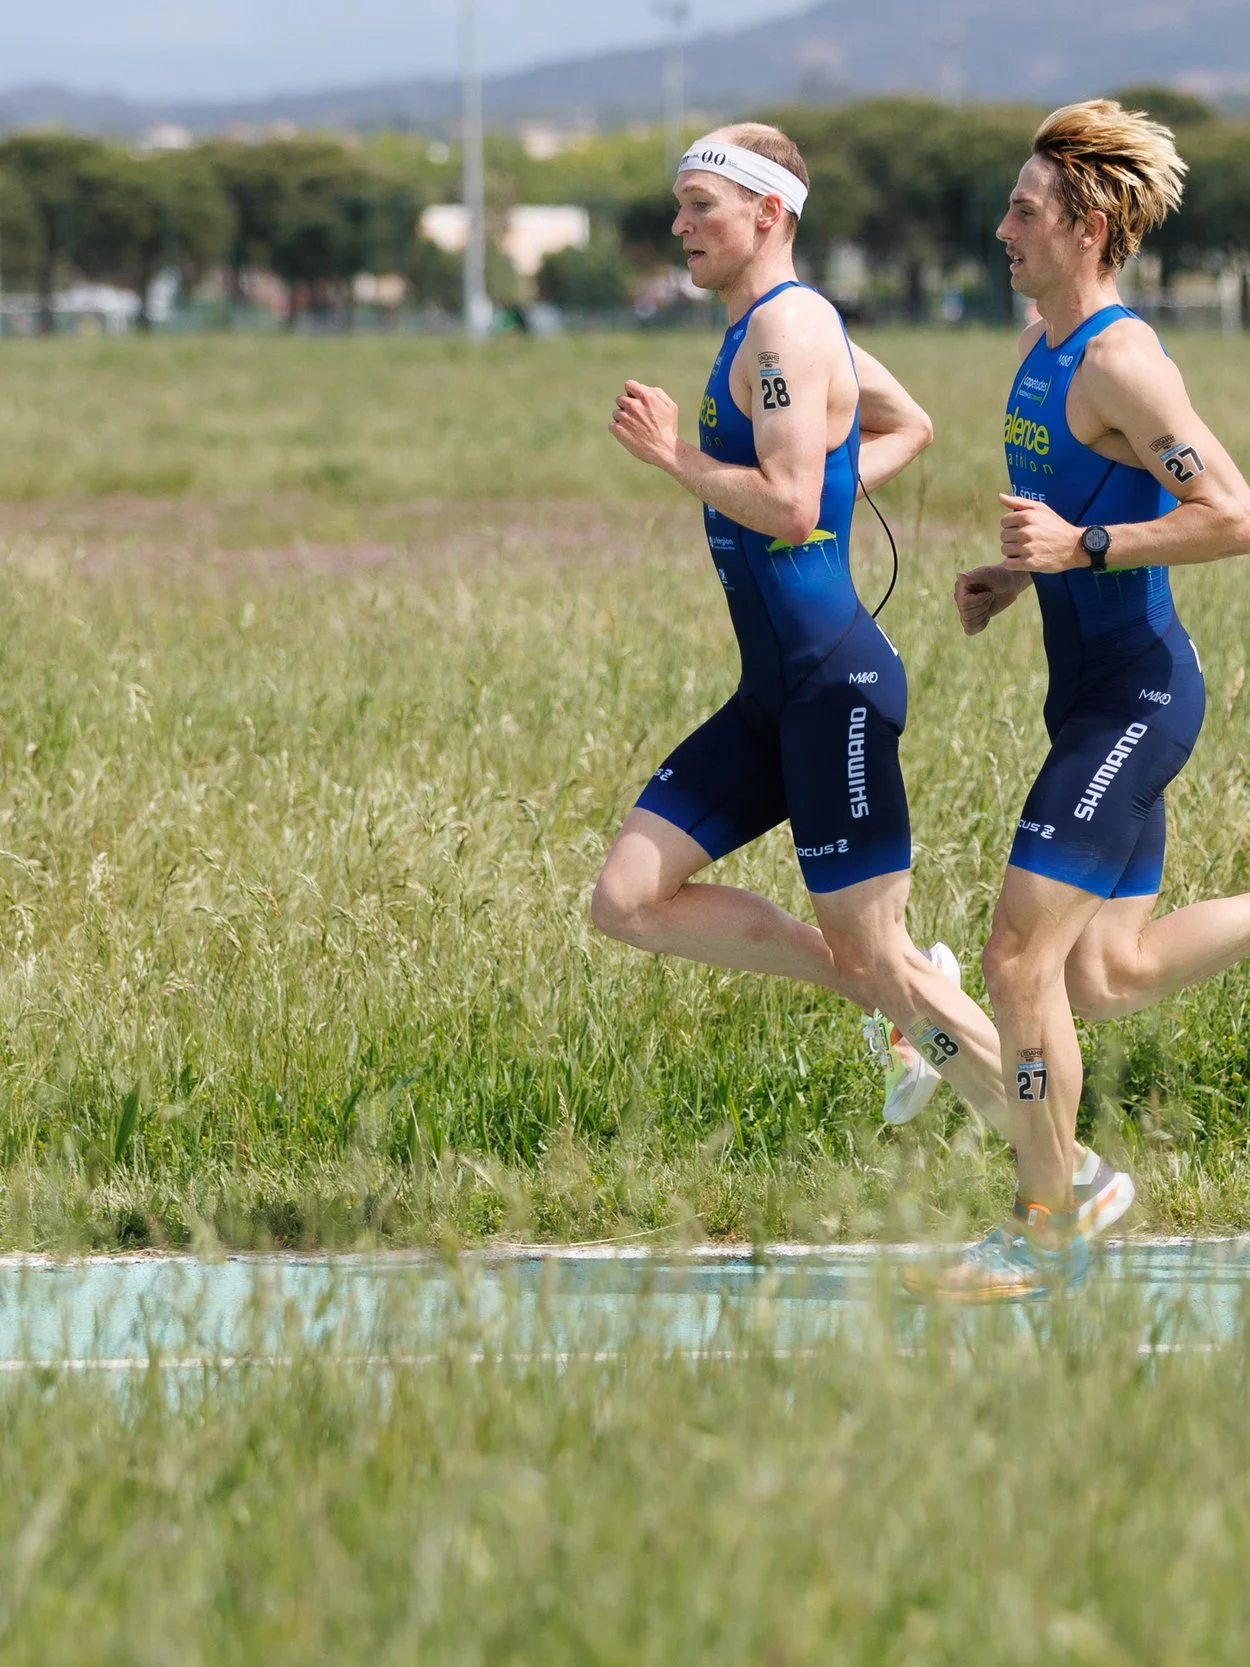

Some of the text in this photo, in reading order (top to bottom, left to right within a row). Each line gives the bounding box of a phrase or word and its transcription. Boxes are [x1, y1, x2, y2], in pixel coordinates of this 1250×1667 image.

[761, 377, 792, 410] 28
[1163, 445, 1206, 484] 27
[849, 671, 878, 684] MAKO
[1138, 688, 1171, 705] MAKO
[848, 706, 870, 819] SHIMANO
[1073, 721, 1149, 822] SHIMANO
[795, 843, 835, 857] OCUS
[920, 1031, 960, 1067] 28
[1016, 1069, 1047, 1101] 27
